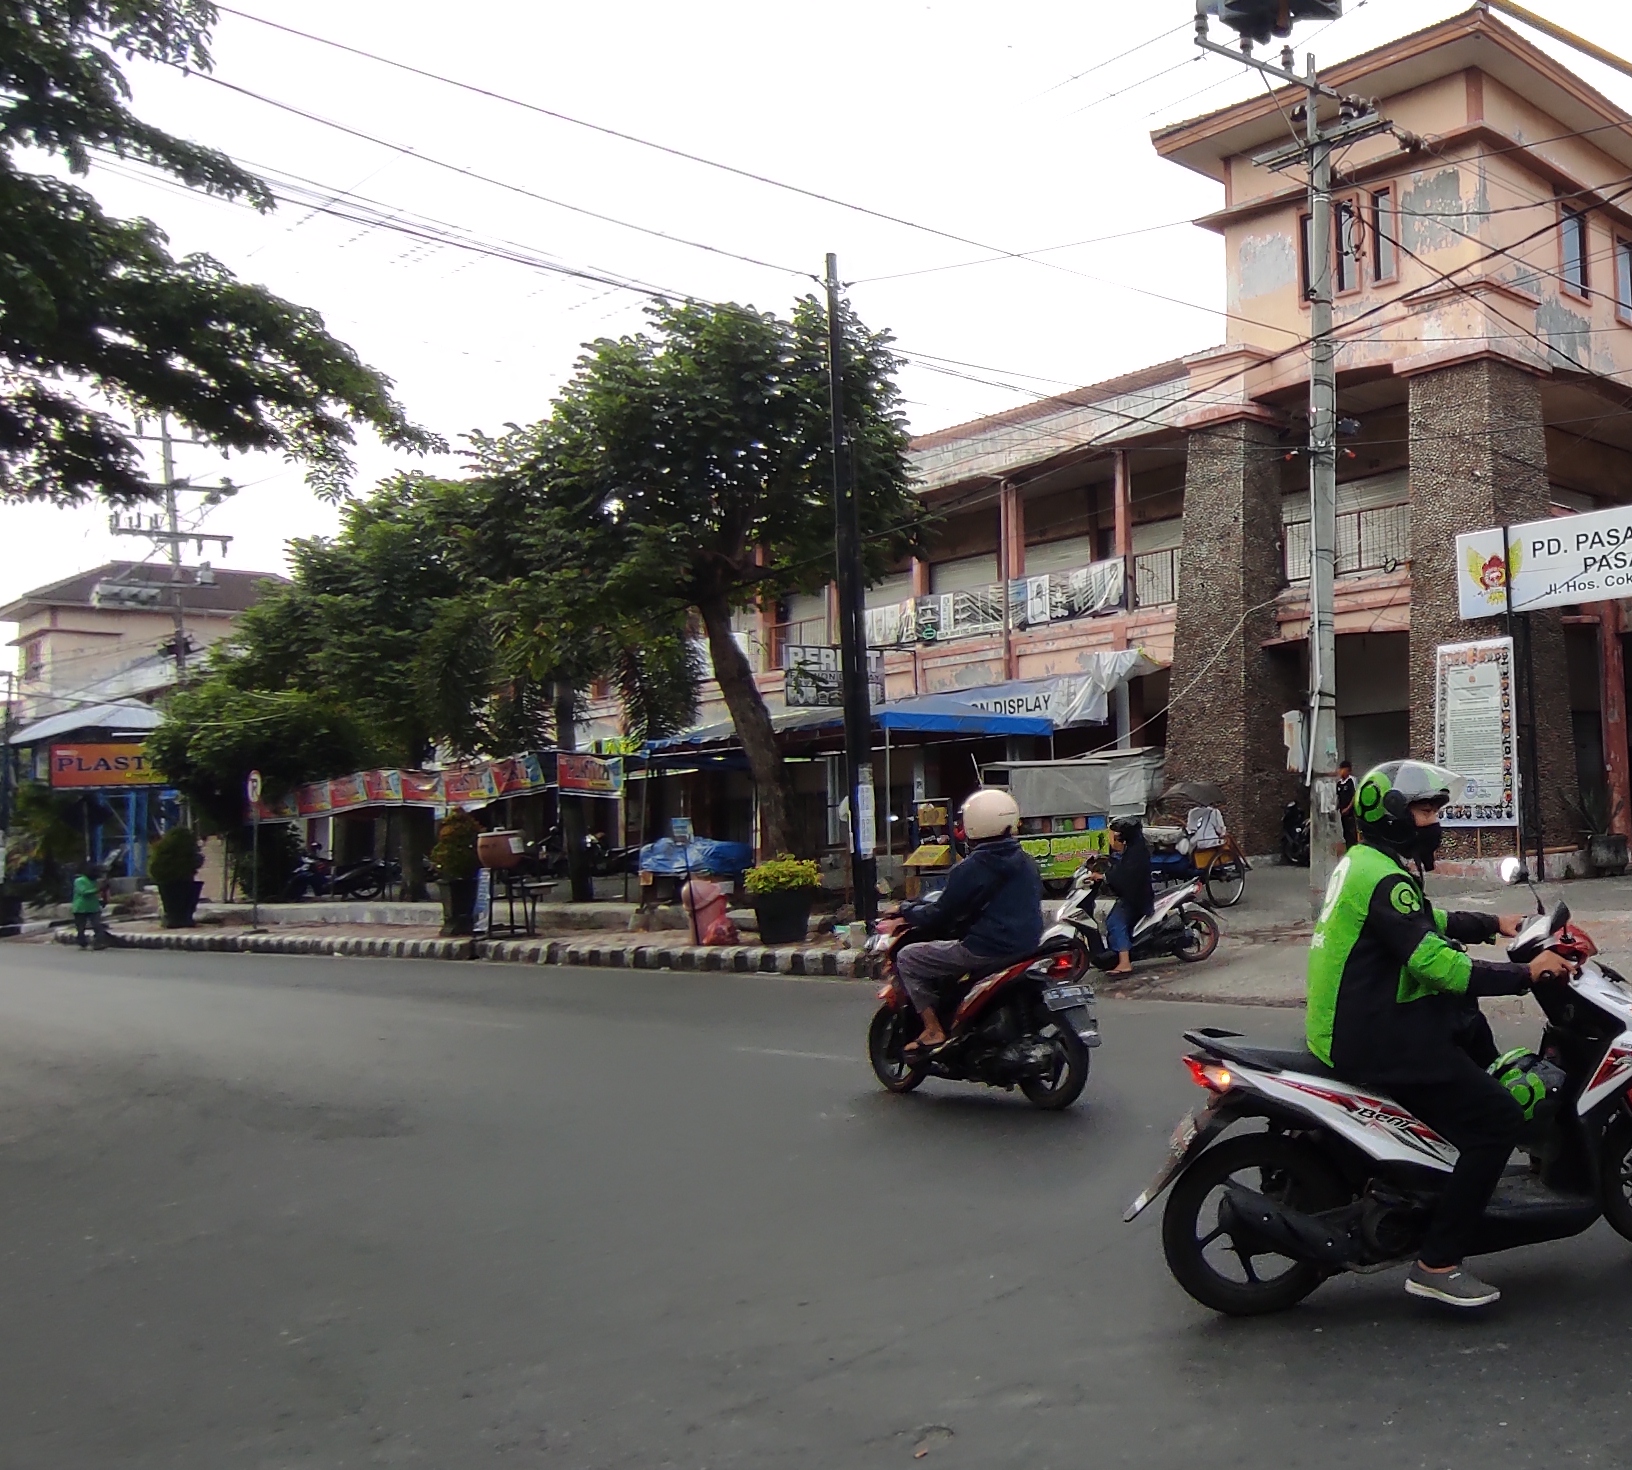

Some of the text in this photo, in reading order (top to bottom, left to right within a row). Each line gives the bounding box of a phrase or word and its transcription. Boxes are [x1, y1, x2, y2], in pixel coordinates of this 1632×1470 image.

[1532, 538, 1568, 559] PD.
[1567, 579, 1600, 593] Hos.
[994, 694, 1051, 715] DISPLAY
